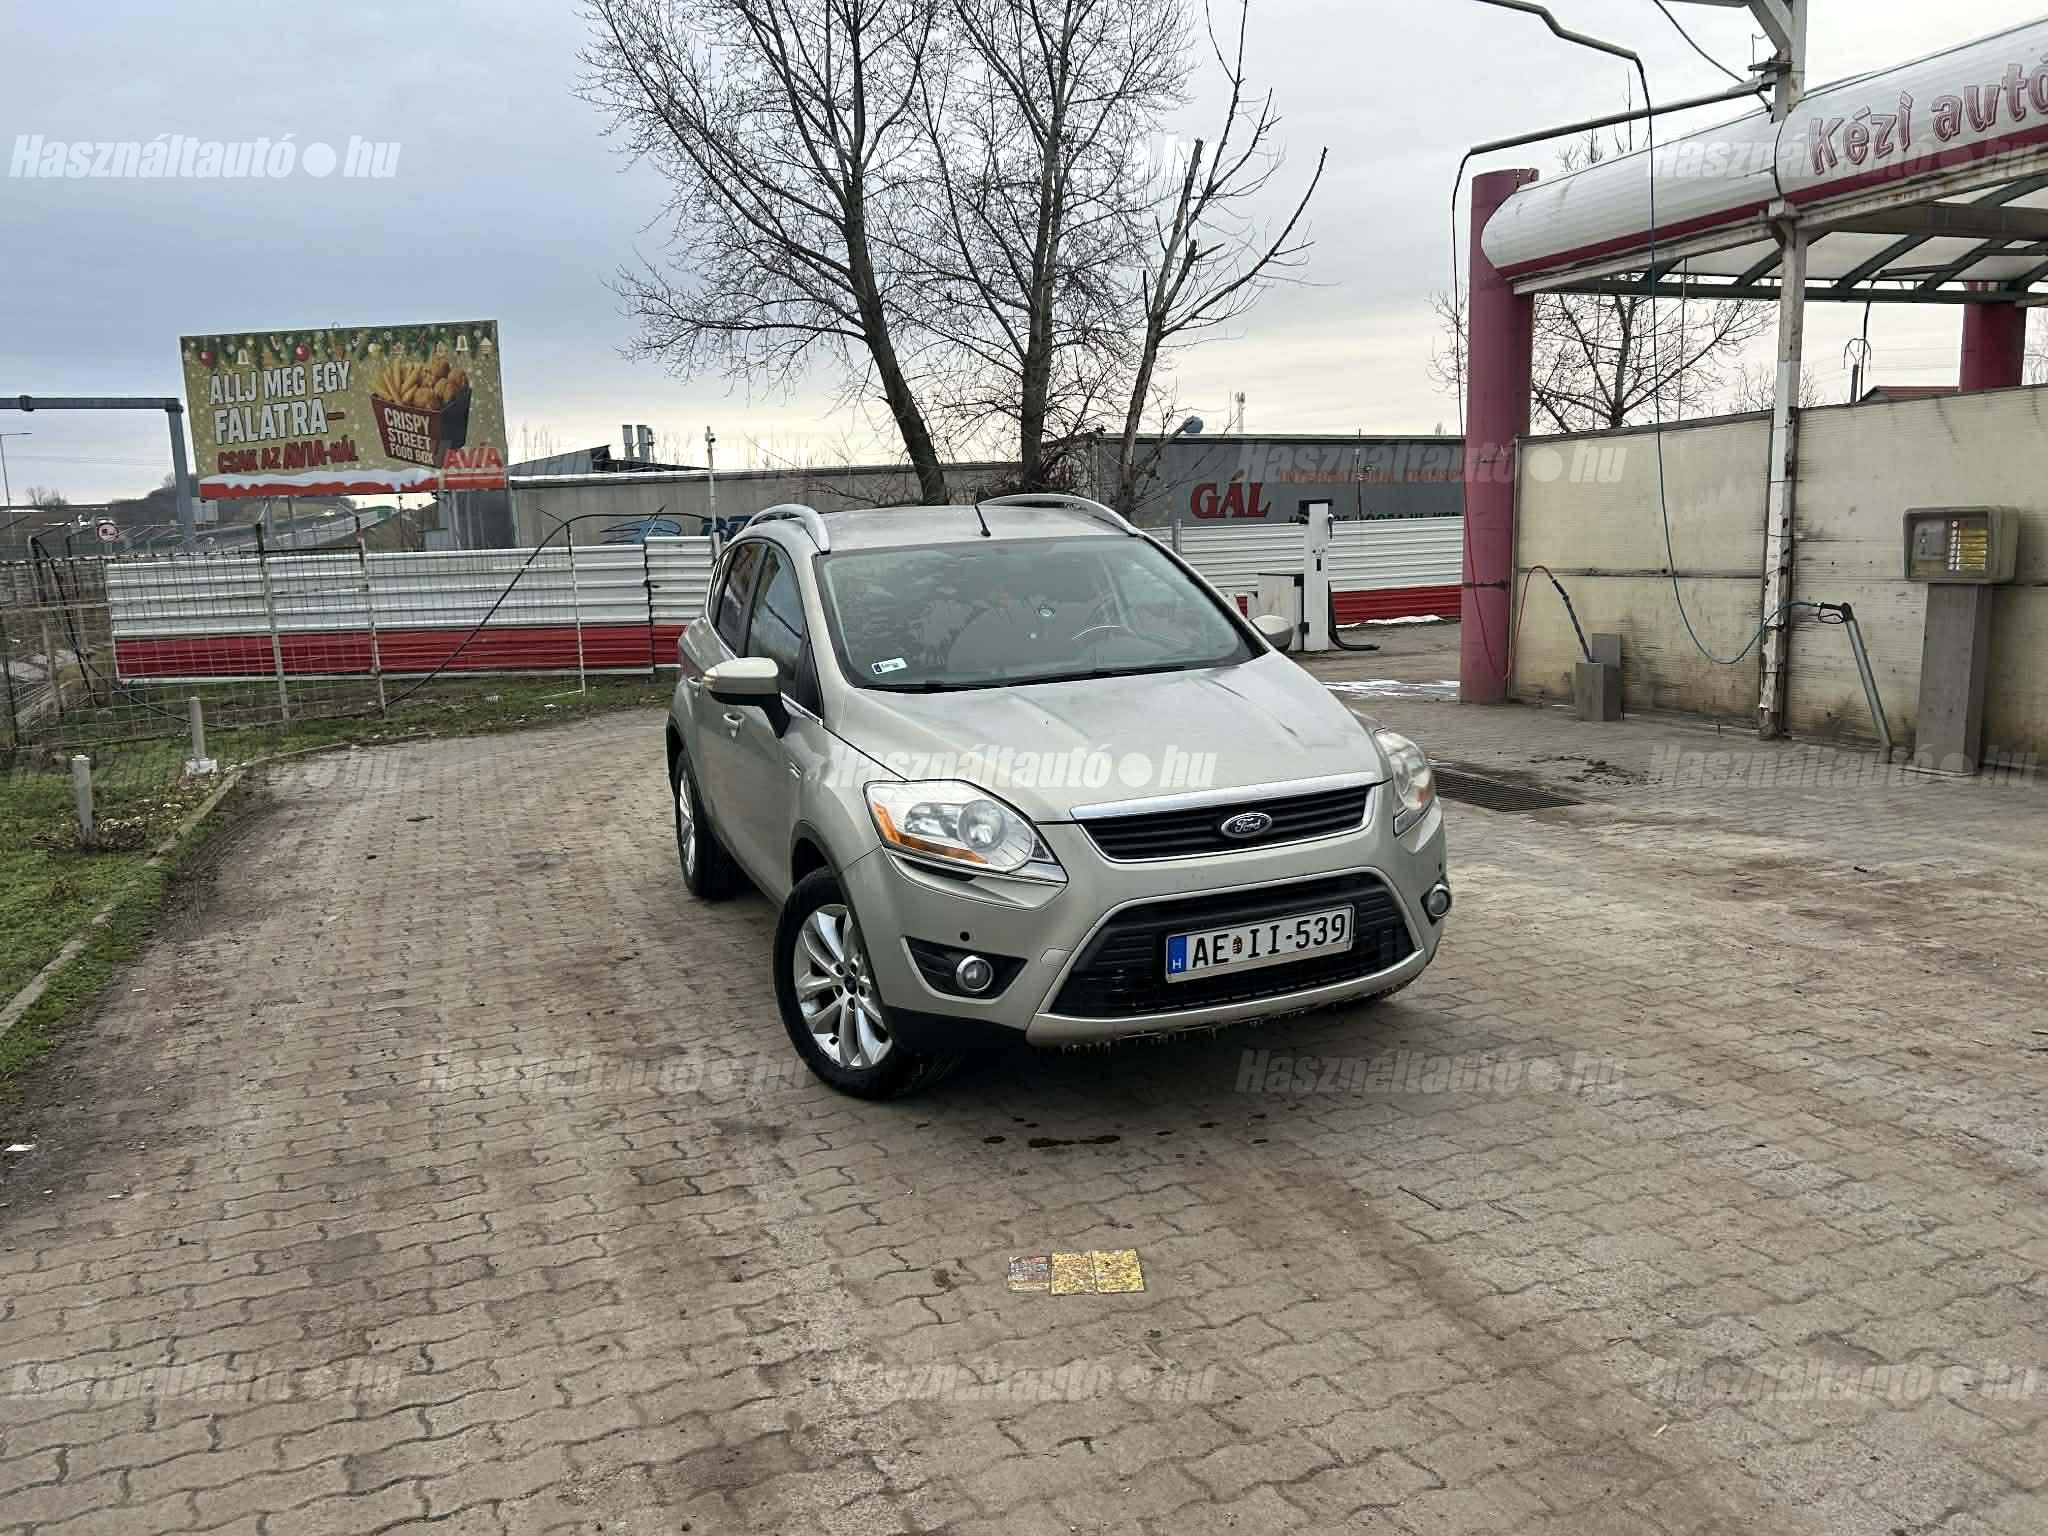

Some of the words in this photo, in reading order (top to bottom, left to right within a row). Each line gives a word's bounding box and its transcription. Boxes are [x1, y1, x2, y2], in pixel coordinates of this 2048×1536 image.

[1808, 90, 1914, 176] Kézi
[263, 365, 306, 400] MEG
[312, 360, 350, 394] EGY
[384, 408, 430, 435] CRISPY
[387, 428, 431, 450] STREET
[261, 447, 282, 469] AZ
[390, 442, 414, 460] FOOD
[415, 449, 434, 465] BOX
[1190, 468, 1272, 518] GÁL
[1235, 816, 1262, 833] Ford
[1172, 959, 1182, 969] H
